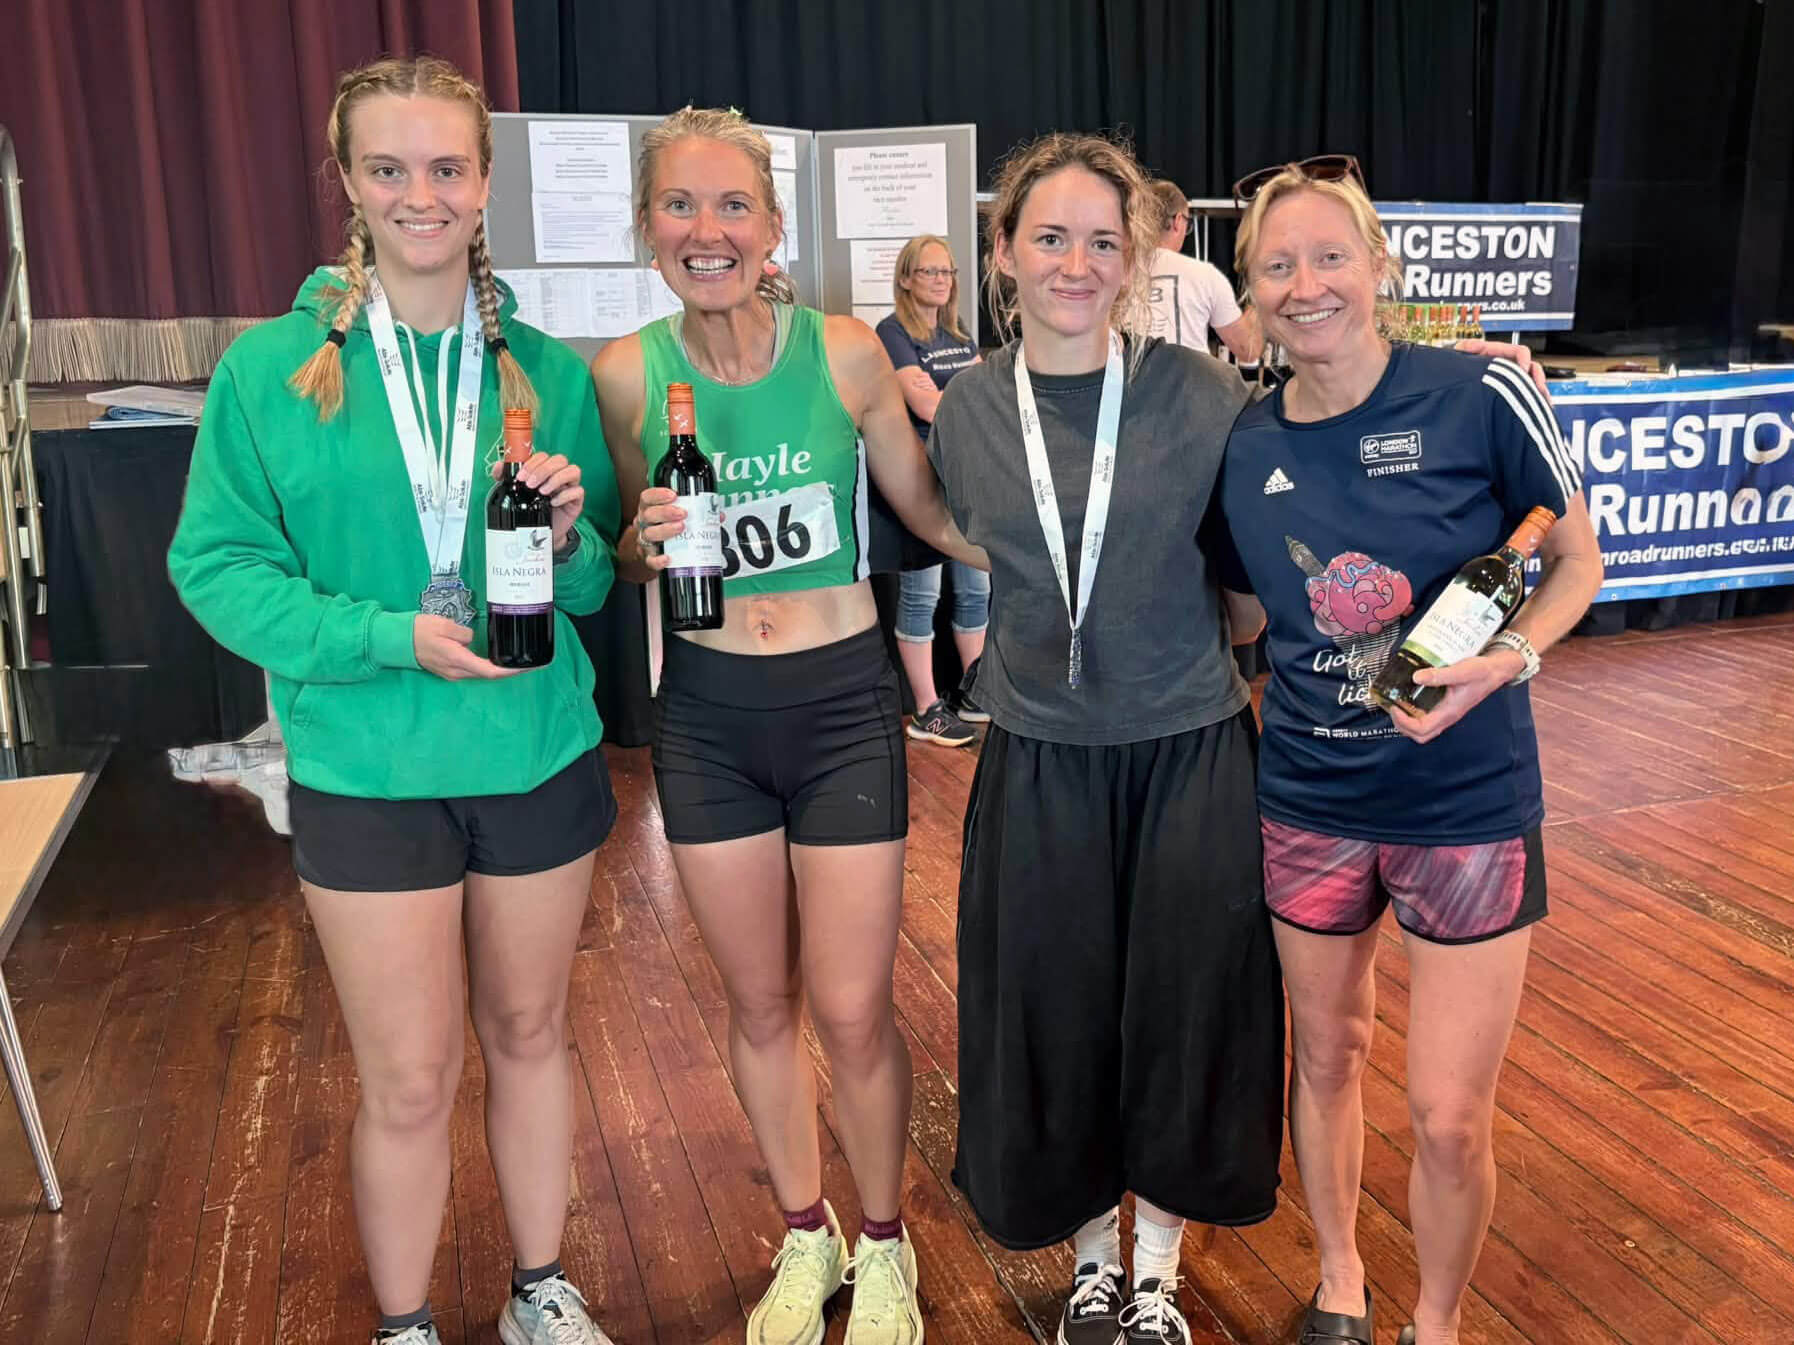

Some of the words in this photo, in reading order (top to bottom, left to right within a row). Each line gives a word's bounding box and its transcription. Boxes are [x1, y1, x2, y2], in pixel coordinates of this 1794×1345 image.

[1404, 264, 1552, 298] Runners
[1562, 412, 1794, 474] NCESTO
[1367, 462, 1420, 478] FINISHER
[1263, 480, 1295, 495] adidas
[492, 566, 510, 577] ISLA
[512, 566, 547, 577] NEGRA
[1313, 643, 1361, 673] Got
[1332, 730, 1358, 738] WORLD
[1360, 727, 1399, 737] MARATHO
